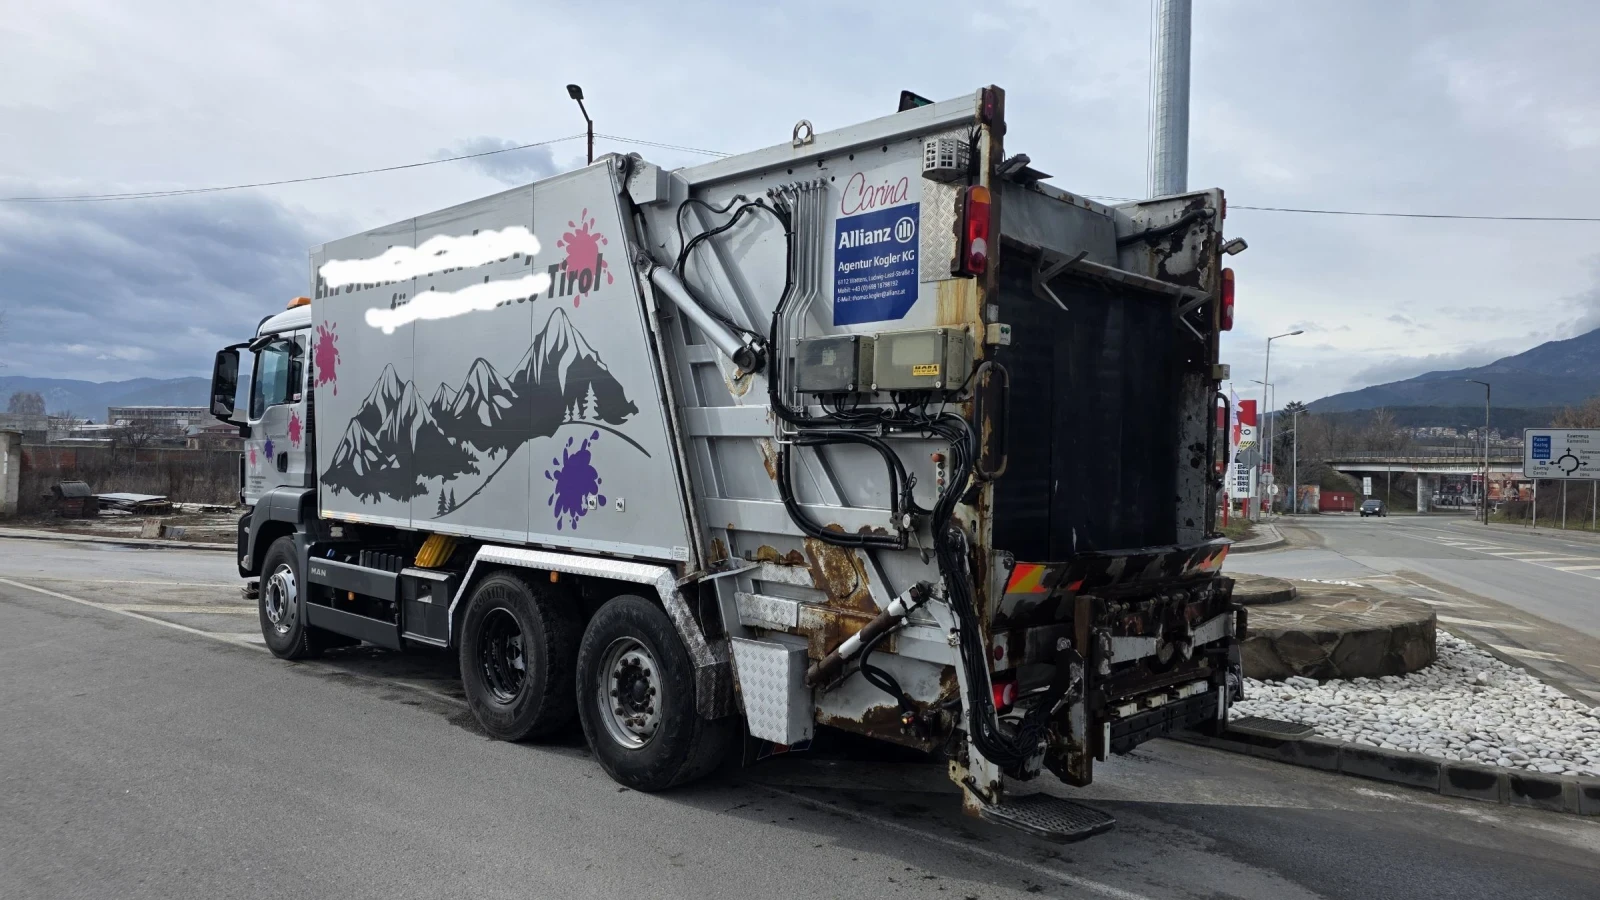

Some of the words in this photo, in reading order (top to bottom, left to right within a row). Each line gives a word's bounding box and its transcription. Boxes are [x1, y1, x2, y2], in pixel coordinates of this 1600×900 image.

[842, 172, 908, 215] Carina
[838, 228, 891, 250] Allianz
[838, 259, 872, 274] Agentur
[873, 252, 901, 268] Kogler
[902, 249, 915, 261] KG
[548, 253, 603, 299] Tirol
[913, 365, 938, 373] MOBA
[311, 567, 326, 577] MAN
